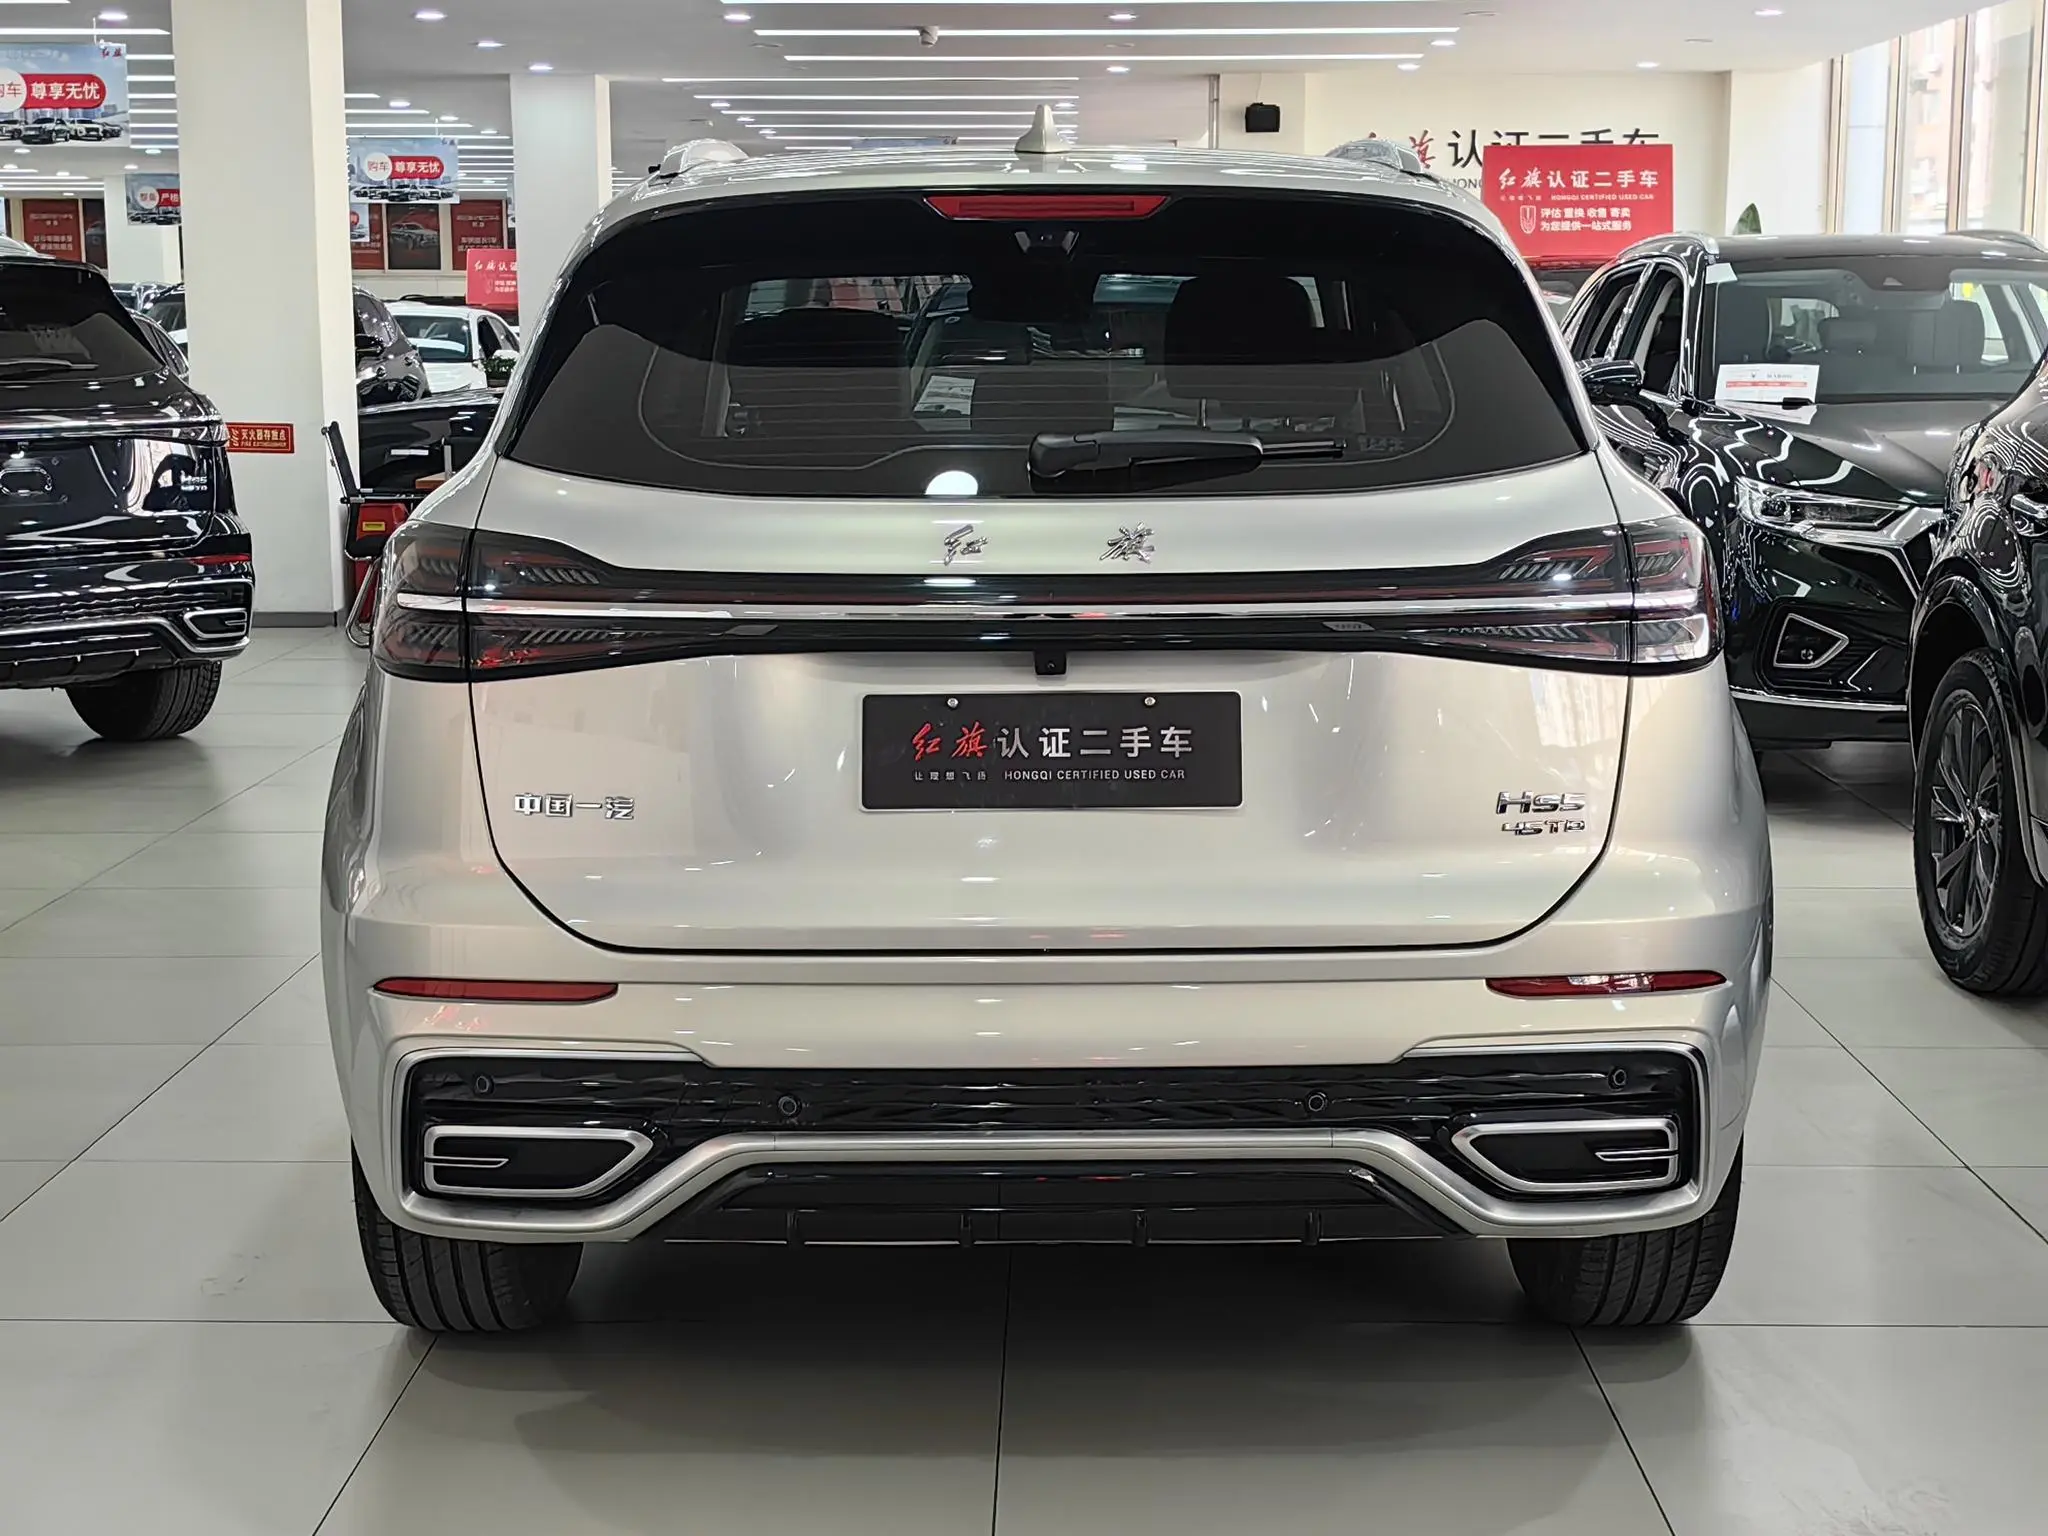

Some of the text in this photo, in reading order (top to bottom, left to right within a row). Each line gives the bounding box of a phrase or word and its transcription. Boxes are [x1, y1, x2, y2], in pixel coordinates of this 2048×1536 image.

[31, 81, 101, 100] 尊享无忧
[394, 160, 440, 174] 尊享无忧
[1498, 167, 1659, 190] 红旗认证二手车
[911, 722, 1192, 761] 红旗认证二手车
[1004, 768, 1187, 786] HONGQI CERTIFIED USED CAR
[514, 793, 635, 820] 中国一汽
[1496, 791, 1586, 815] HS5
